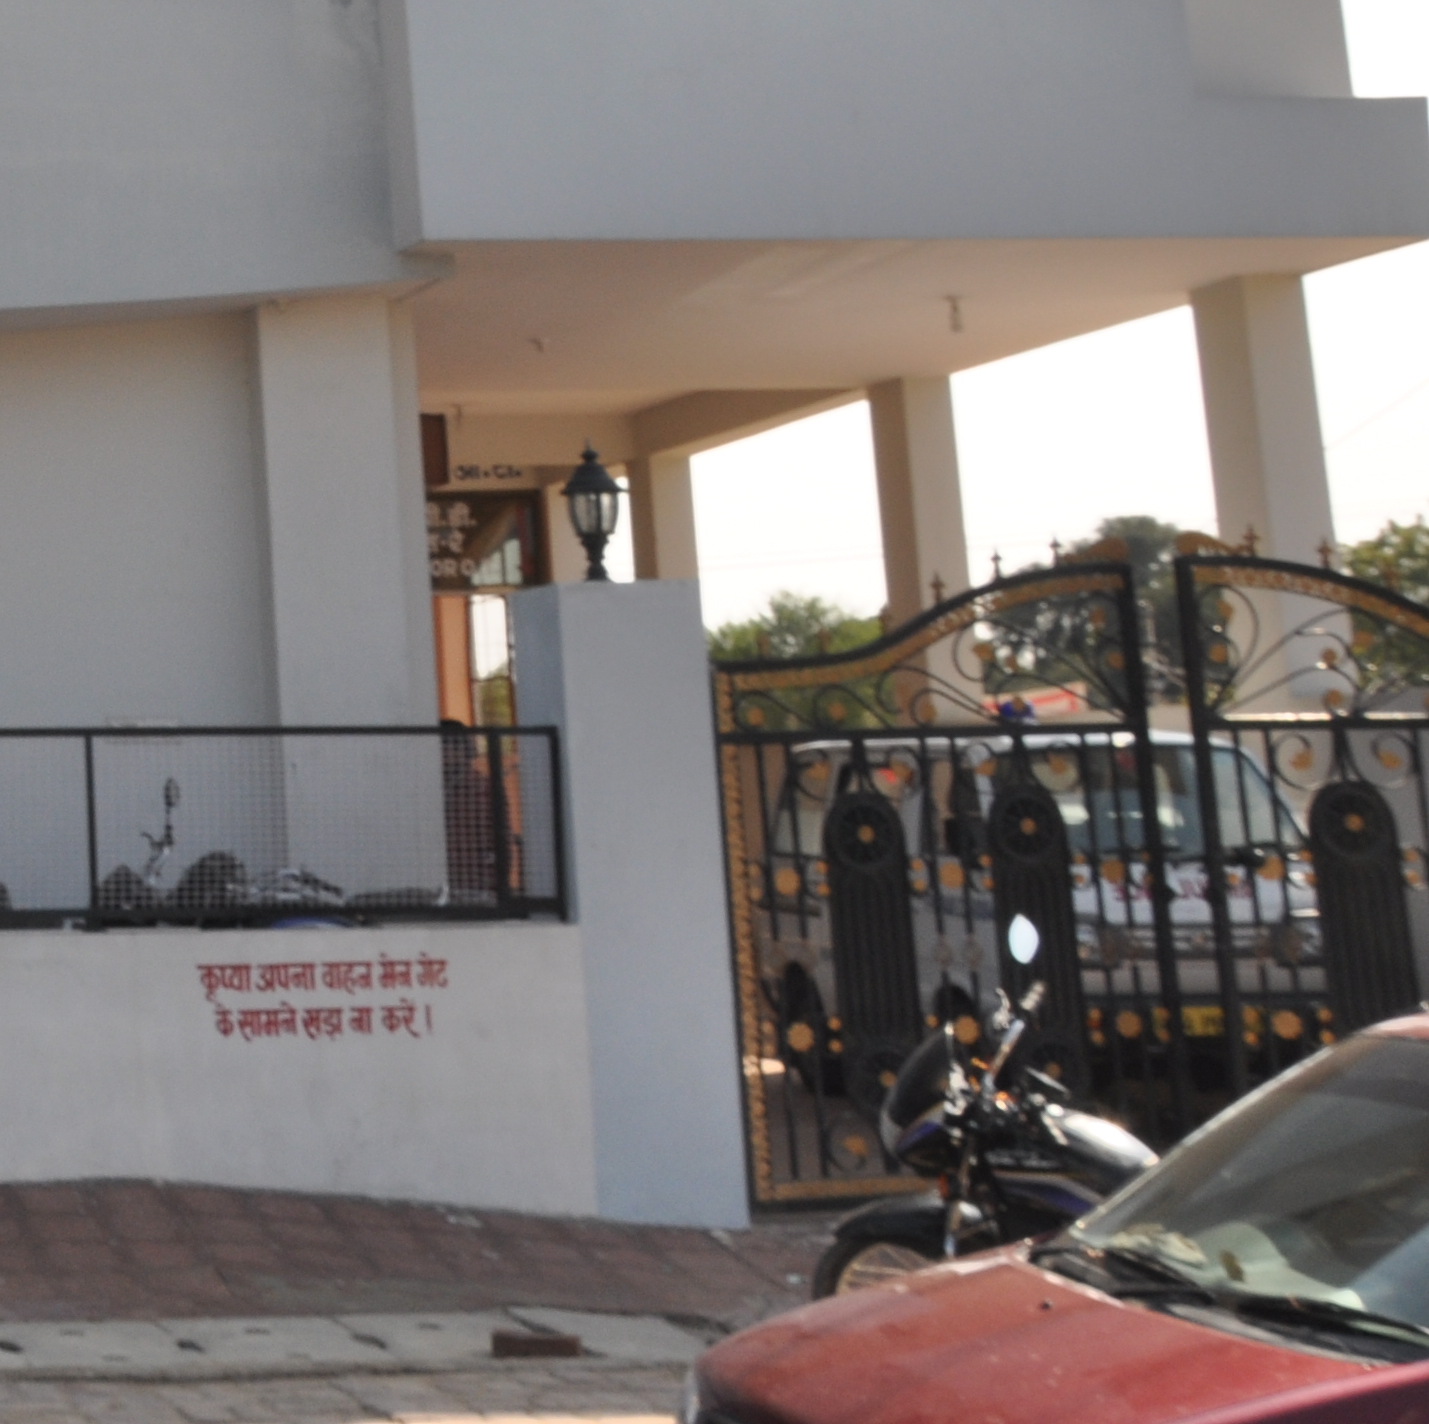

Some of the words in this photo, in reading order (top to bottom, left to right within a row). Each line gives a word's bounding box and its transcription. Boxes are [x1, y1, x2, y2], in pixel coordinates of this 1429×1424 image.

[255, 962, 316, 992] अपना
[321, 960, 373, 995] वाहन
[237, 1000, 298, 1041] सामने
